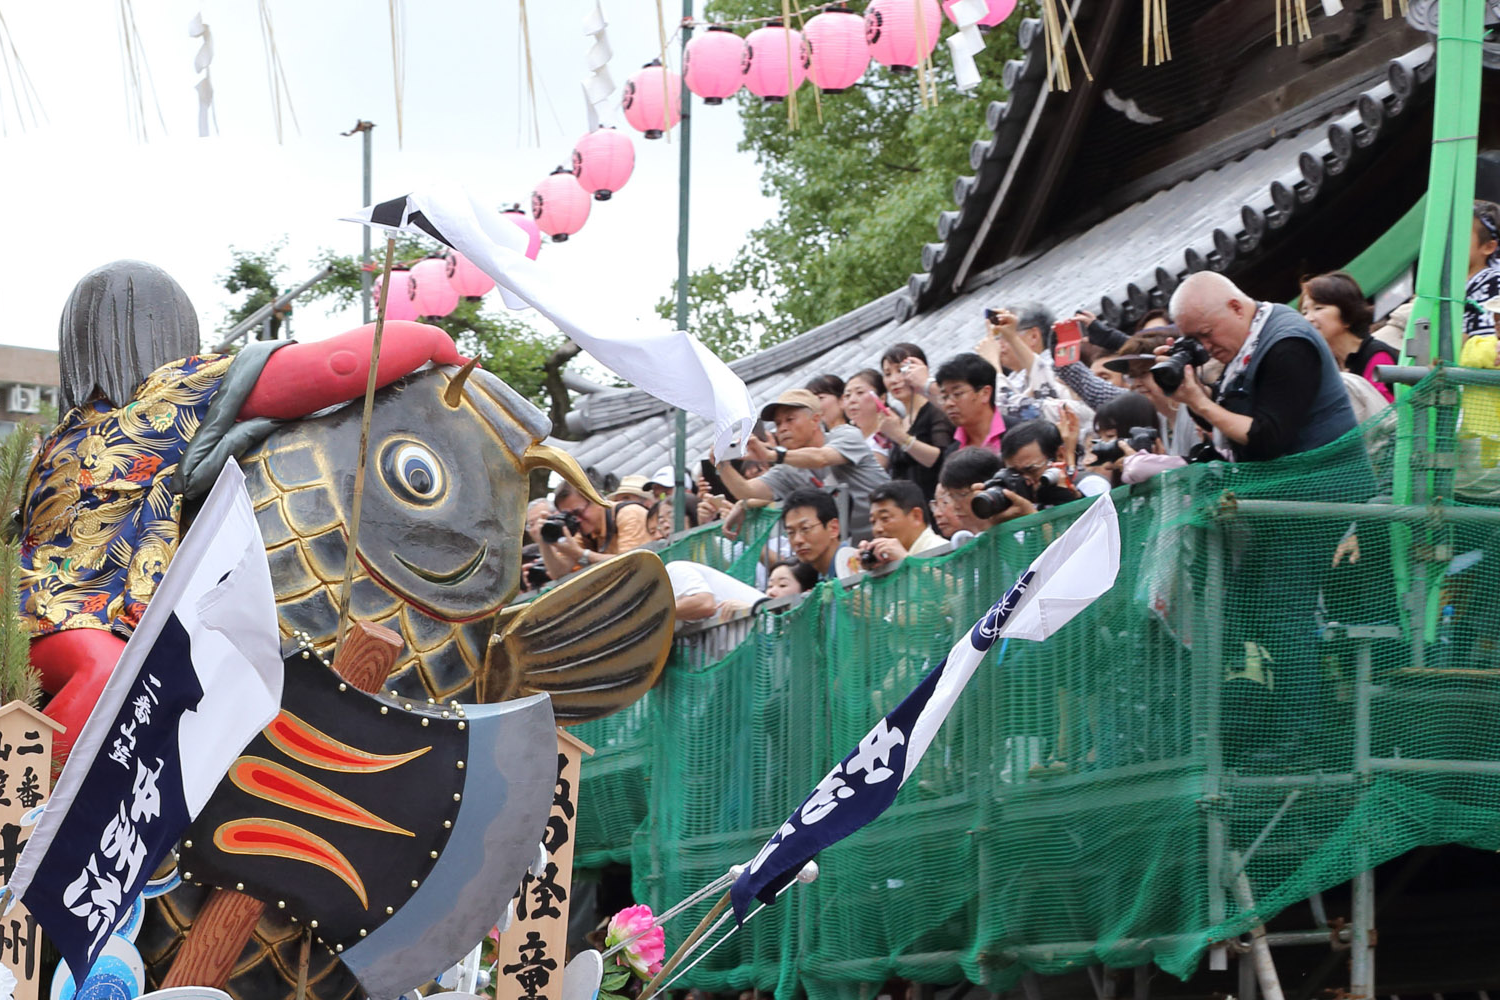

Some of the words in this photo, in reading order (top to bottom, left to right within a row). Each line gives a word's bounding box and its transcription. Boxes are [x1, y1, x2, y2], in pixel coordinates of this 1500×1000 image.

[108, 673, 162, 770] 二番山笠
[16, 730, 44, 809] 二番
